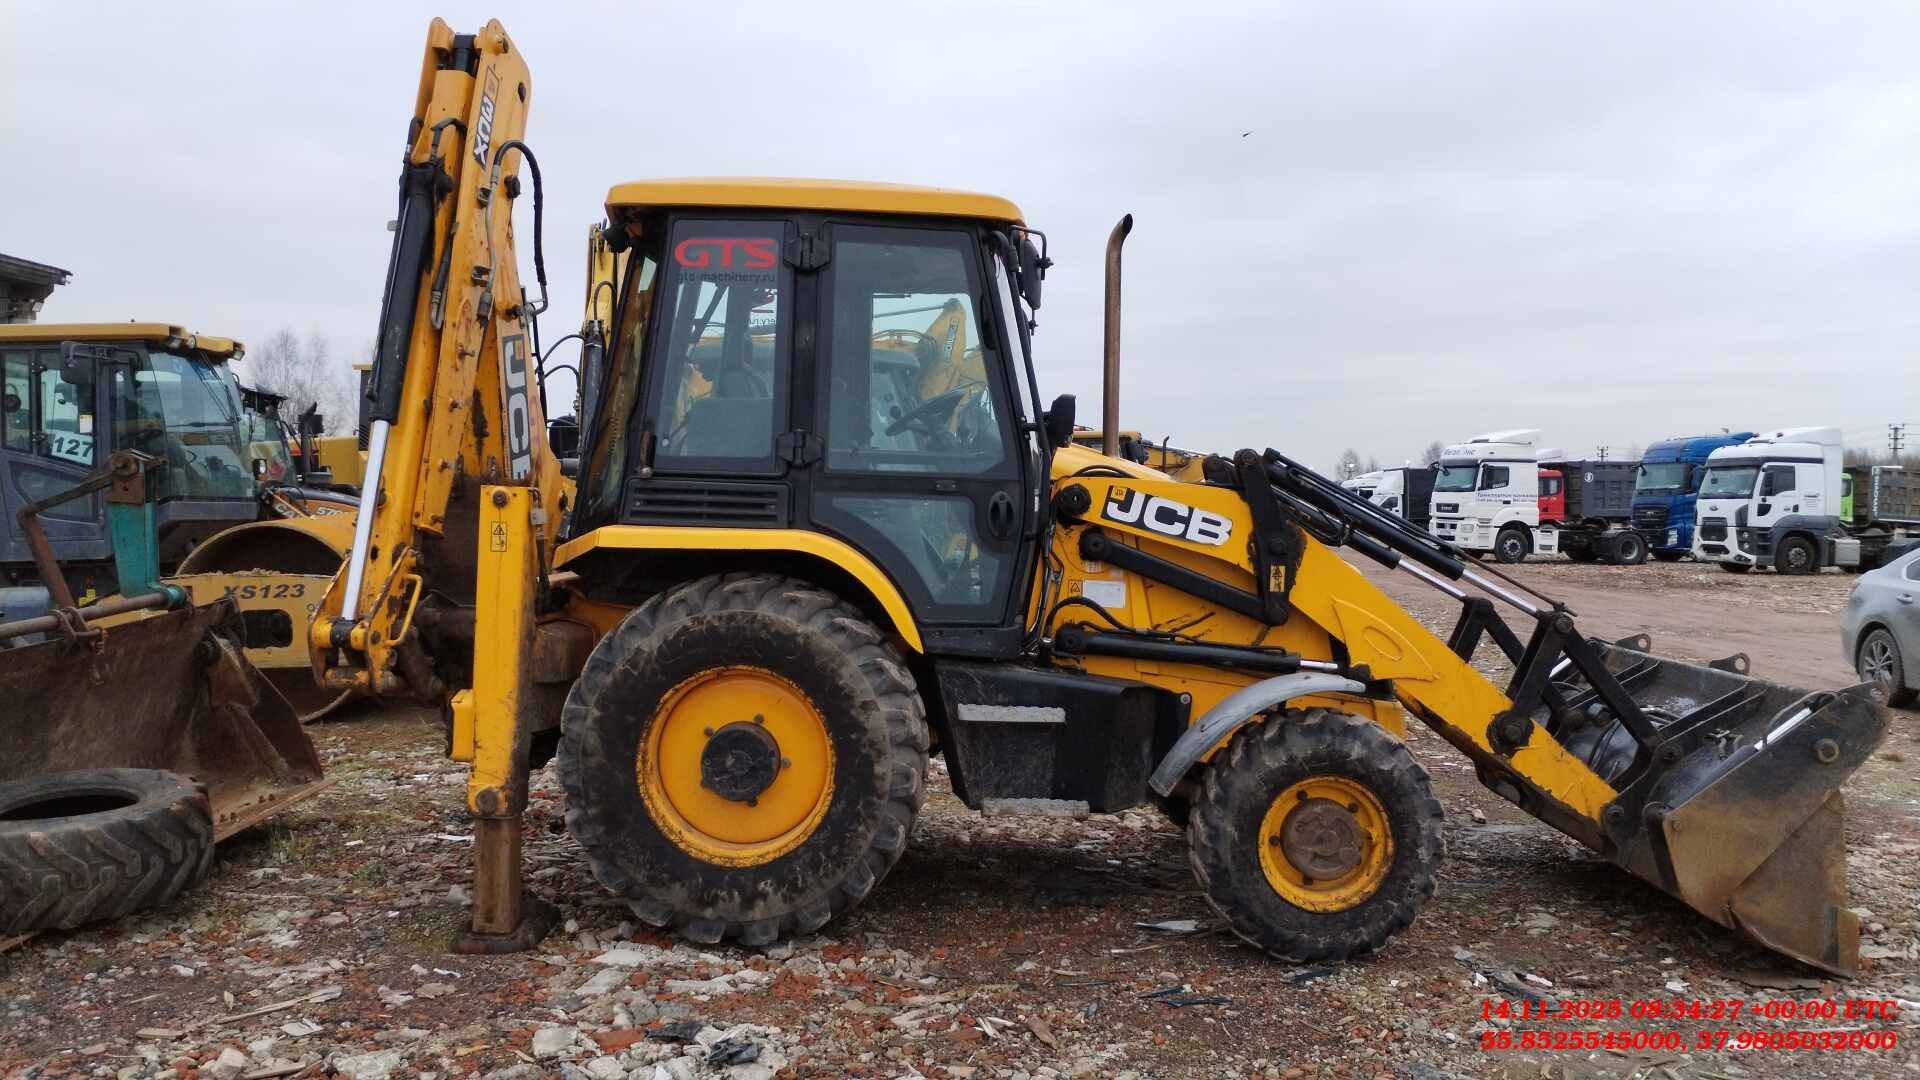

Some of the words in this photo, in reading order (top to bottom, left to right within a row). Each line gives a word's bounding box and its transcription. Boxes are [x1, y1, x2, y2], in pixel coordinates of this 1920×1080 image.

[674, 238, 777, 269] GTS
[54, 436, 94, 457] 127
[1106, 490, 1233, 546] JCB
[224, 584, 305, 599] XS123
